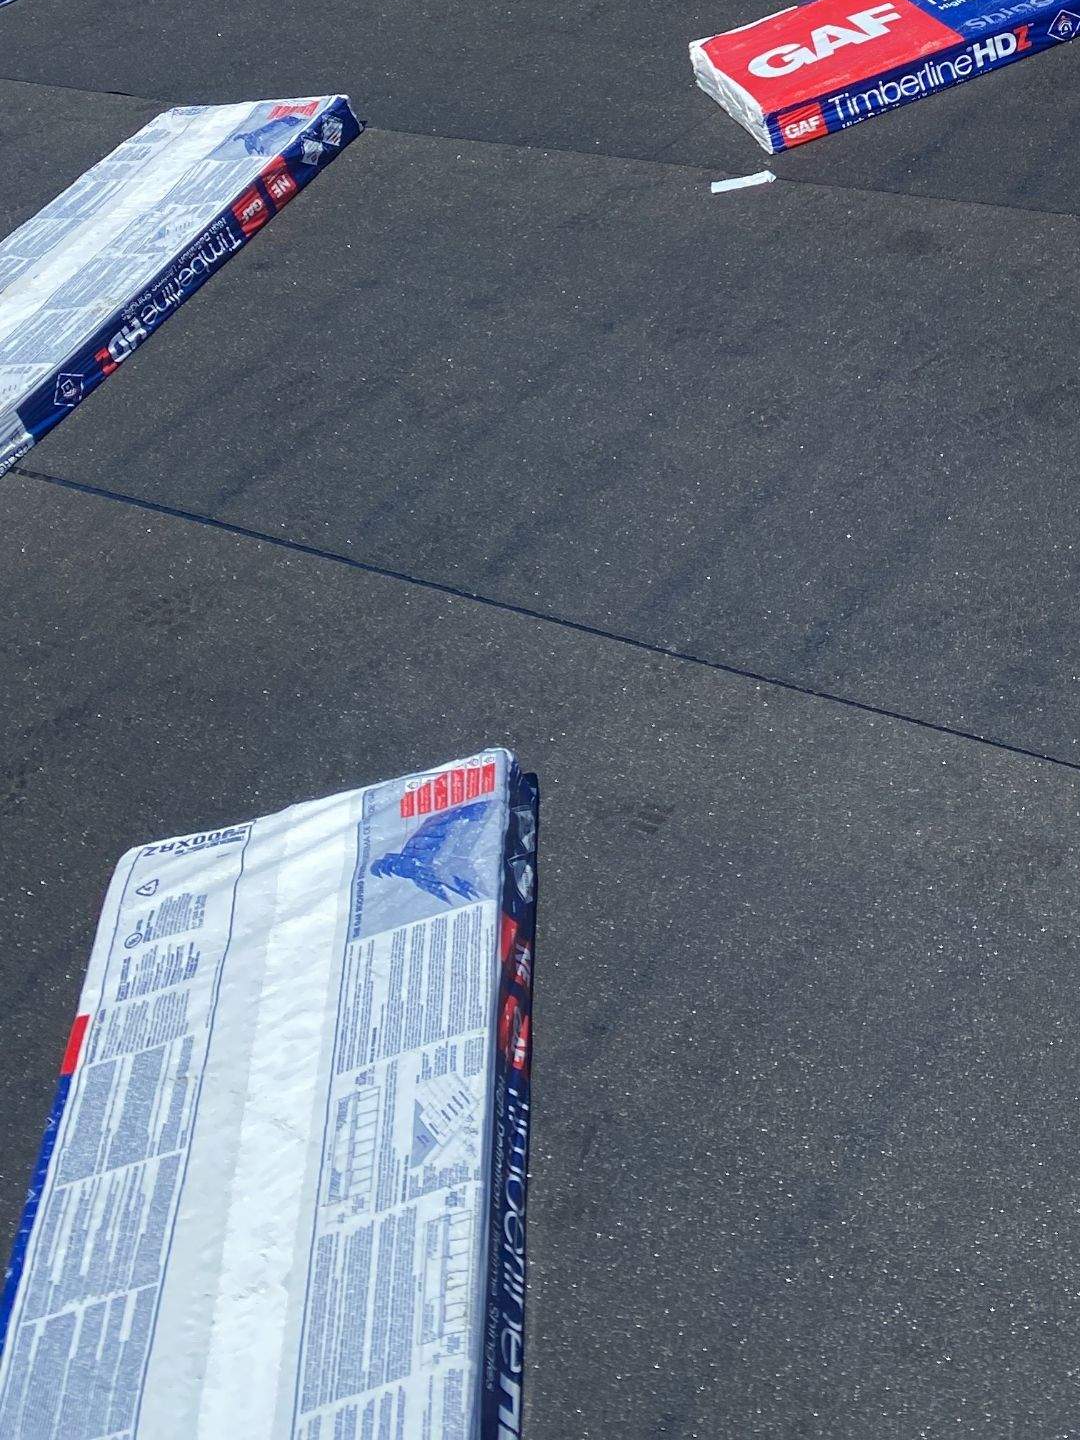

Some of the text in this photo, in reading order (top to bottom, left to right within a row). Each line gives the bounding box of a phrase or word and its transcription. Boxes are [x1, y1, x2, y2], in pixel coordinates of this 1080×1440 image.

[747, 2, 902, 78] GAF
[784, 117, 821, 140] GAF
[272, 174, 292, 200] NE
